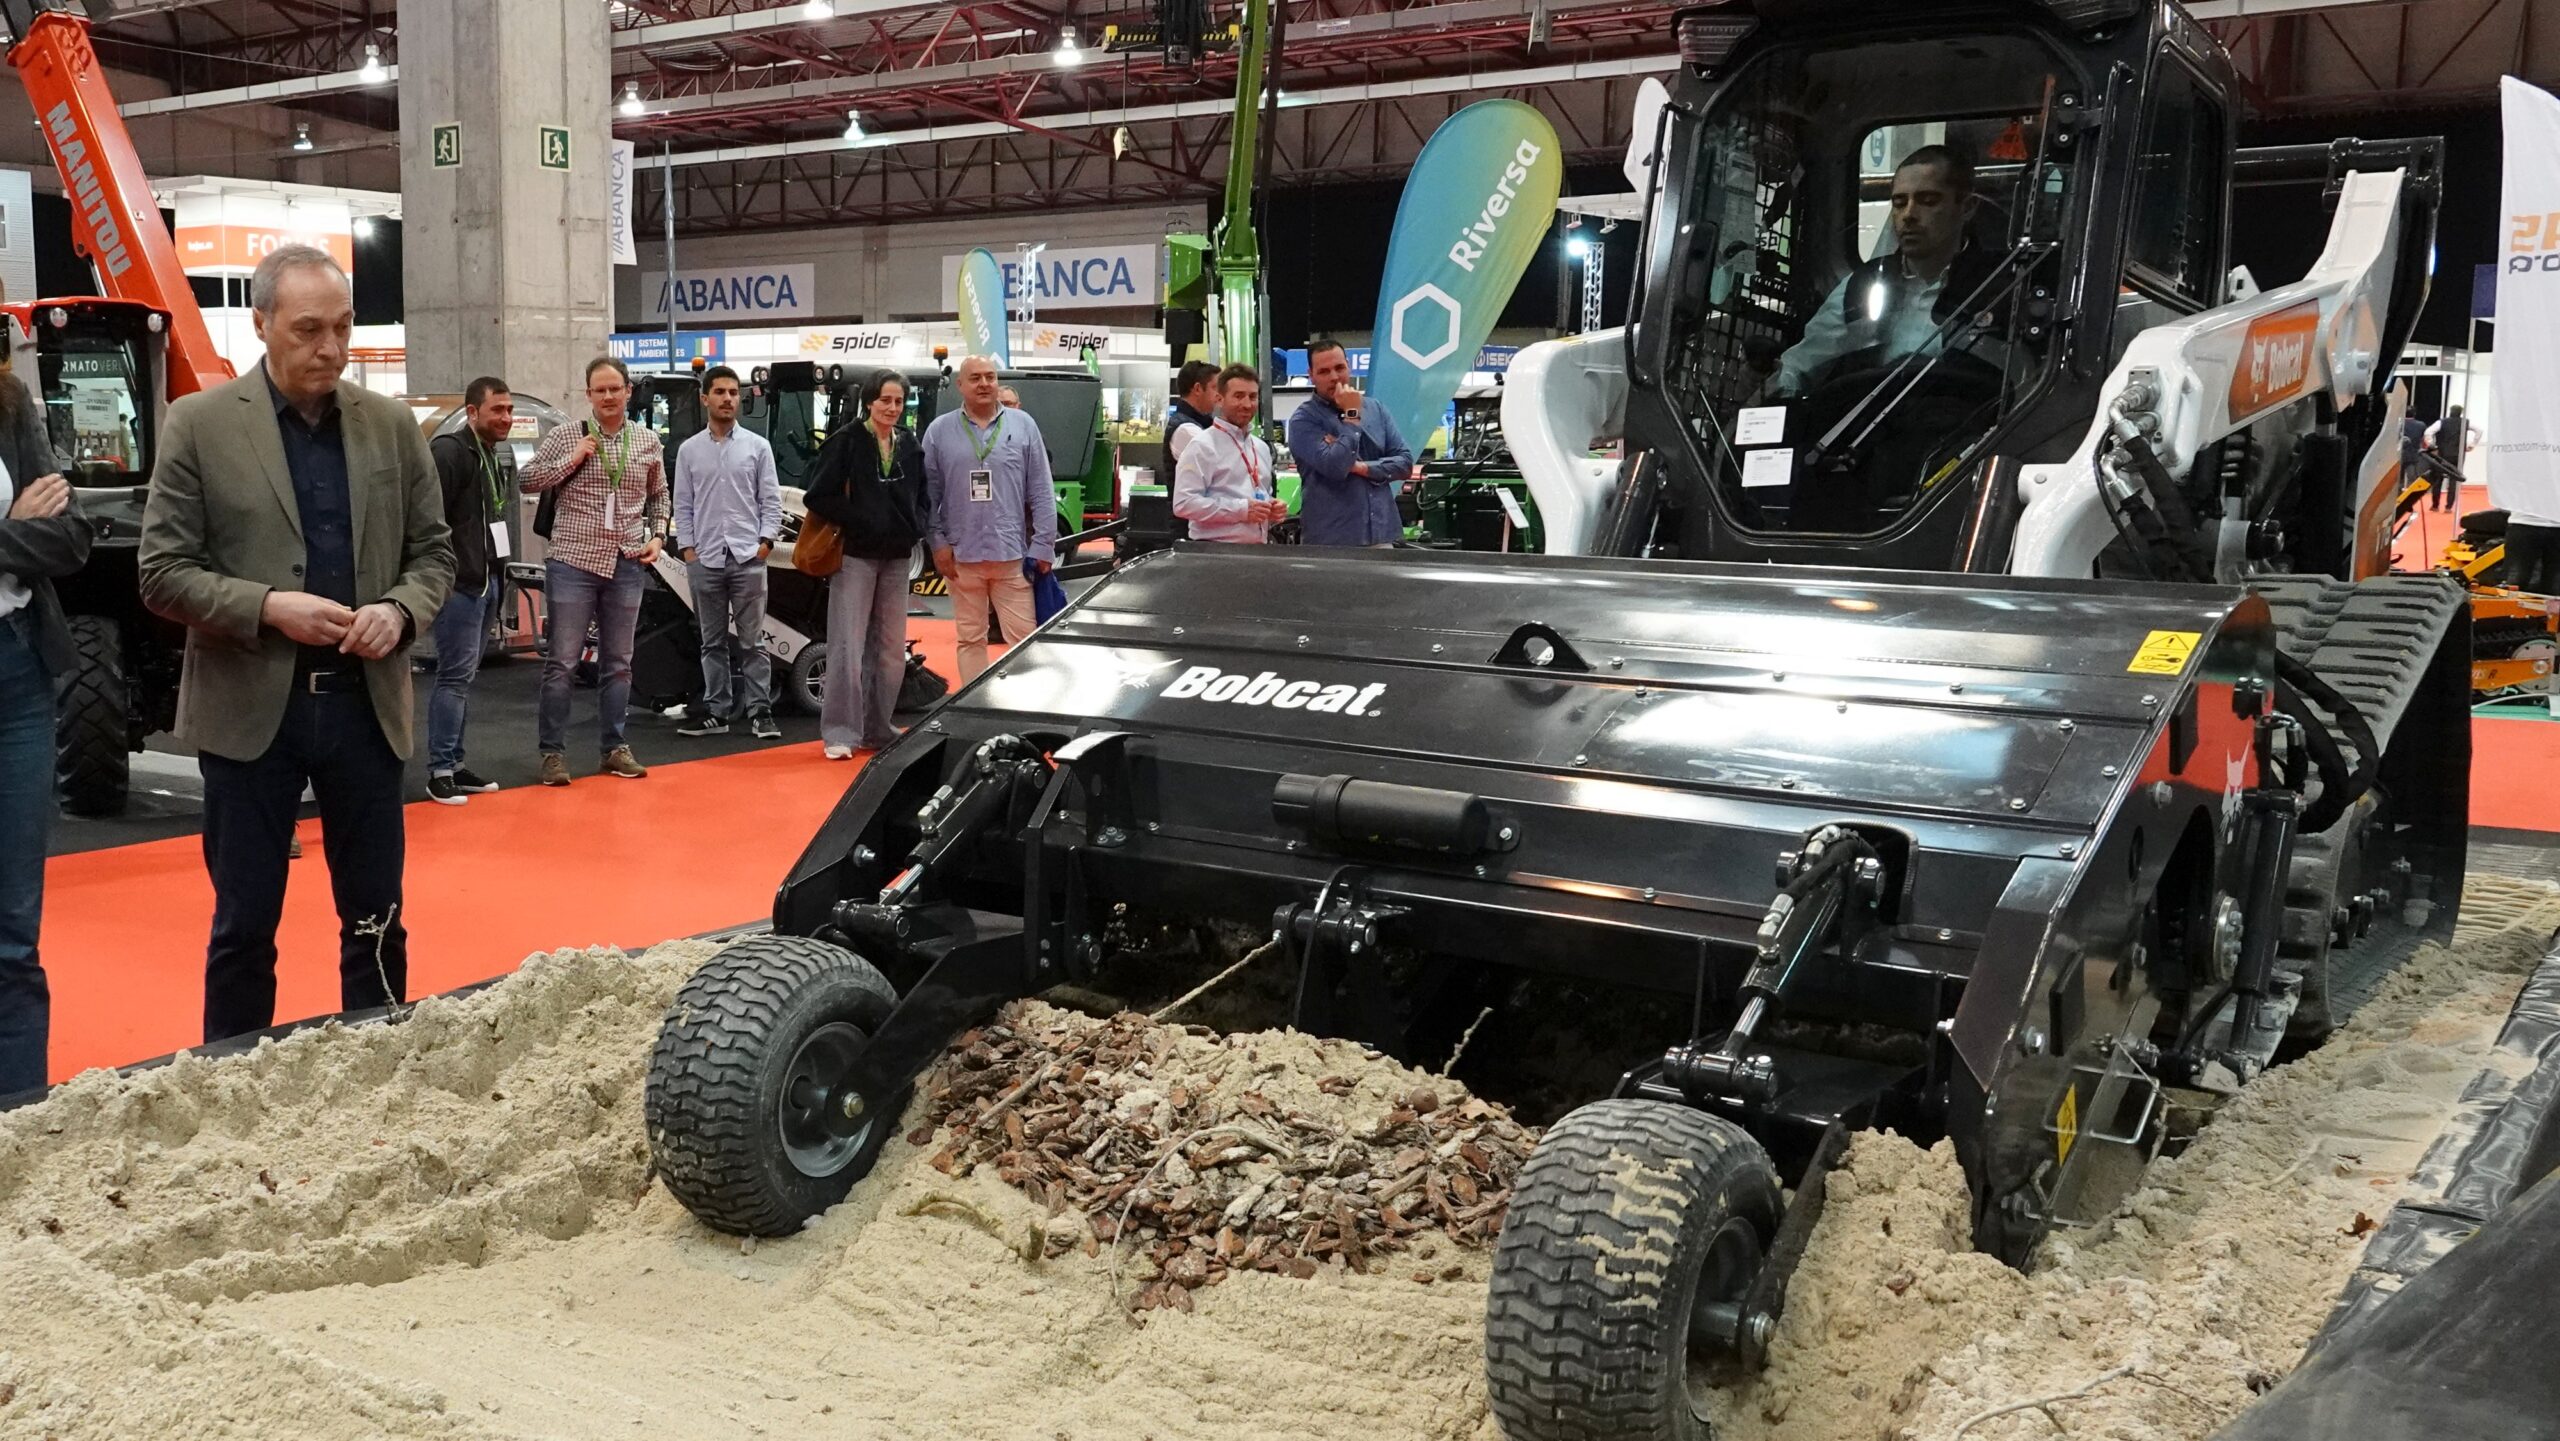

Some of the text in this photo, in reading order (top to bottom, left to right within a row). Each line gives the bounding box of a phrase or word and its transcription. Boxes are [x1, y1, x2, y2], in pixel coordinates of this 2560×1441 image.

[46, 100, 132, 277] MANITOU
[1448, 138, 1541, 272] Riversa
[1001, 256, 1136, 299] BANCA
[638, 339, 668, 347] SISTEMA
[638, 348, 685, 357] AMBIENTES
[832, 332, 901, 353] spider
[1059, 331, 1109, 351] spider
[1486, 354, 1513, 367] ISEK
[2268, 333, 2304, 394] Bobcat
[1159, 665, 1388, 716] Bobcat
